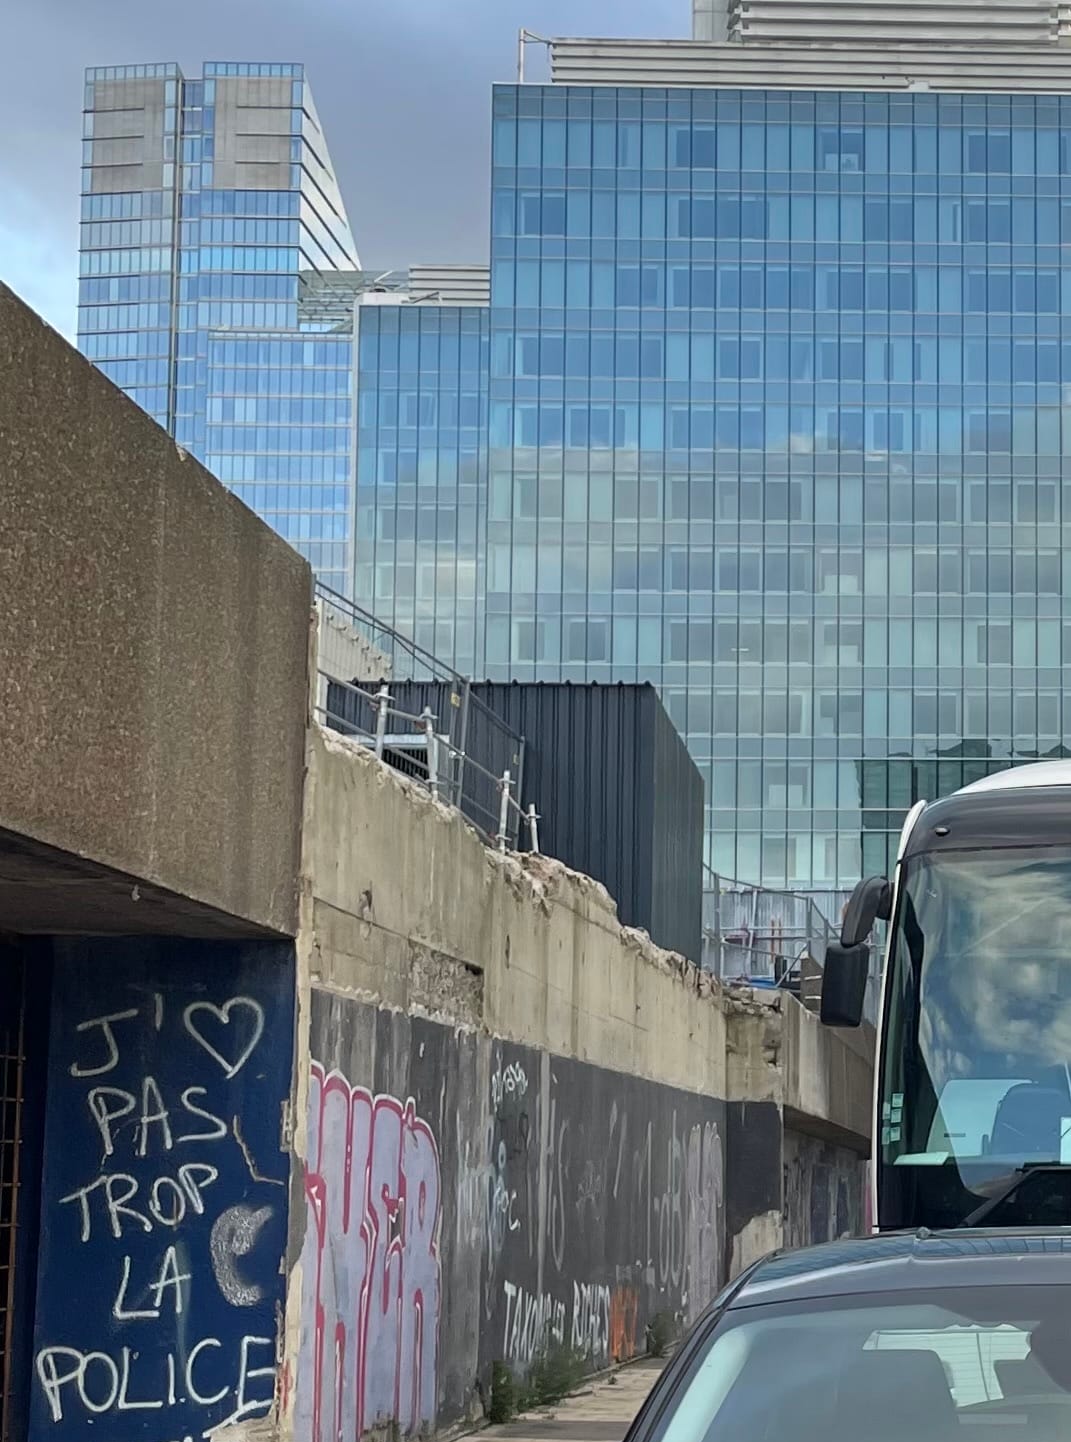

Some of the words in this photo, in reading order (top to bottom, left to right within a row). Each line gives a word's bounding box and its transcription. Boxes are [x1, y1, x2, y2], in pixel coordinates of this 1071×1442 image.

[86, 1076, 227, 1156] PAS
[59, 1163, 219, 1244] TROP
[112, 1245, 191, 1320] LA
[36, 1336, 277, 1423] POLICE
